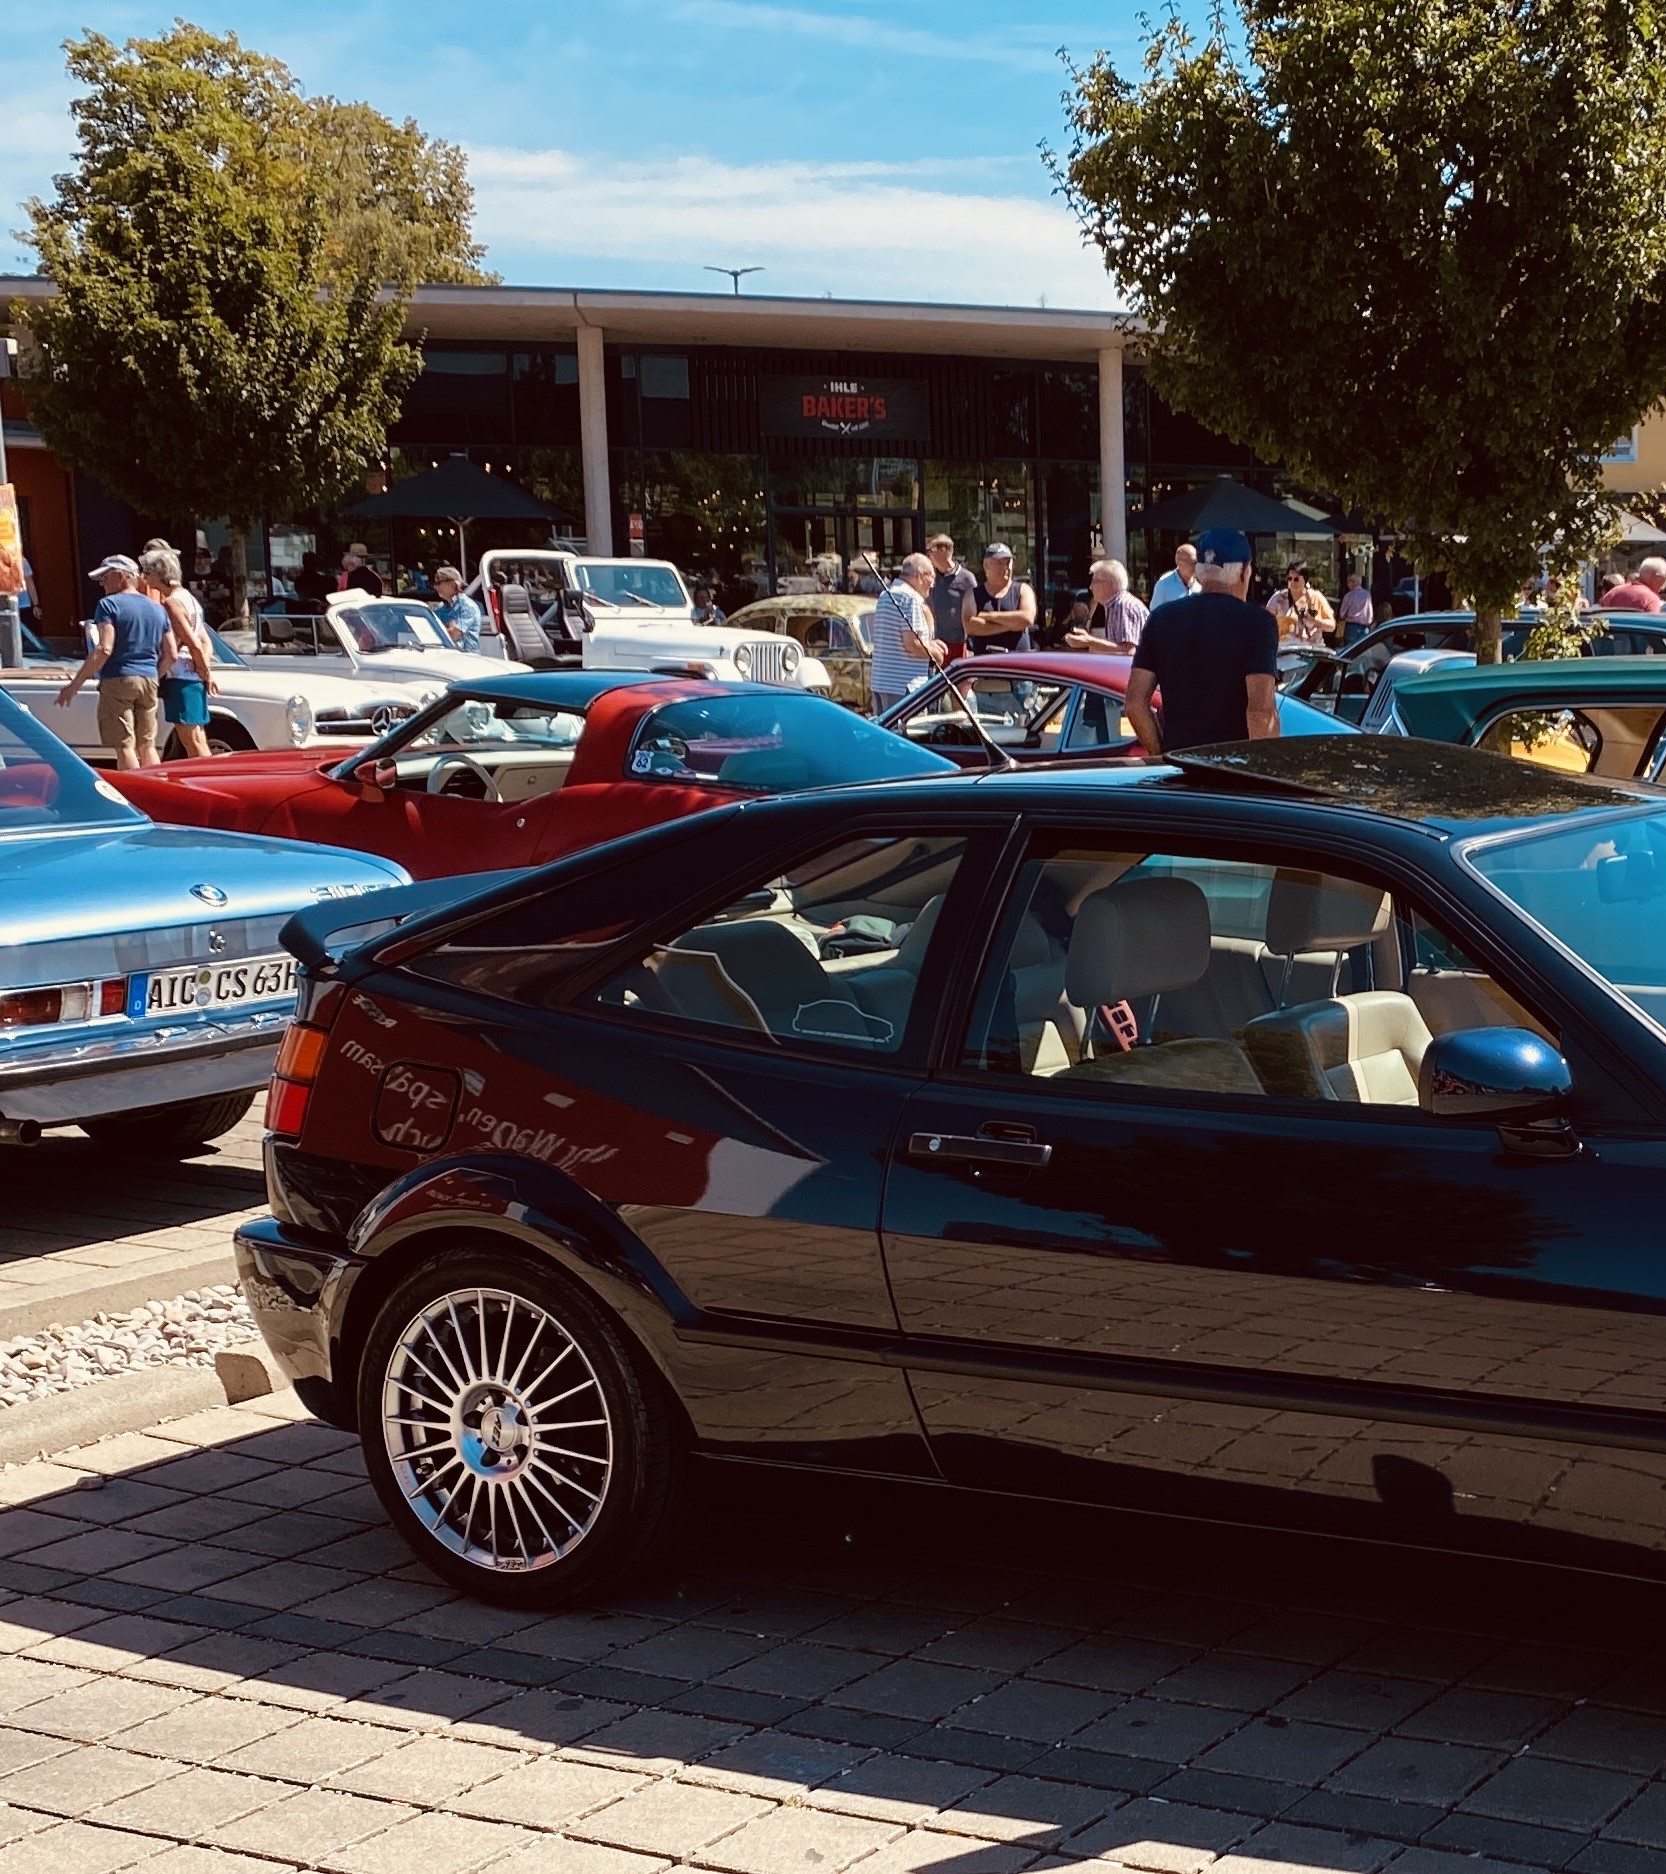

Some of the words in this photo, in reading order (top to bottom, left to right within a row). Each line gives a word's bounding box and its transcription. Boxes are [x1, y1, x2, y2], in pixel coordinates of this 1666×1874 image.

[829, 381, 858, 393] IHLE
[802, 395, 887, 419] BAKER'S
[147, 973, 197, 1010] AIC
[216, 967, 248, 1001] CS
[253, 960, 299, 995] 63H
